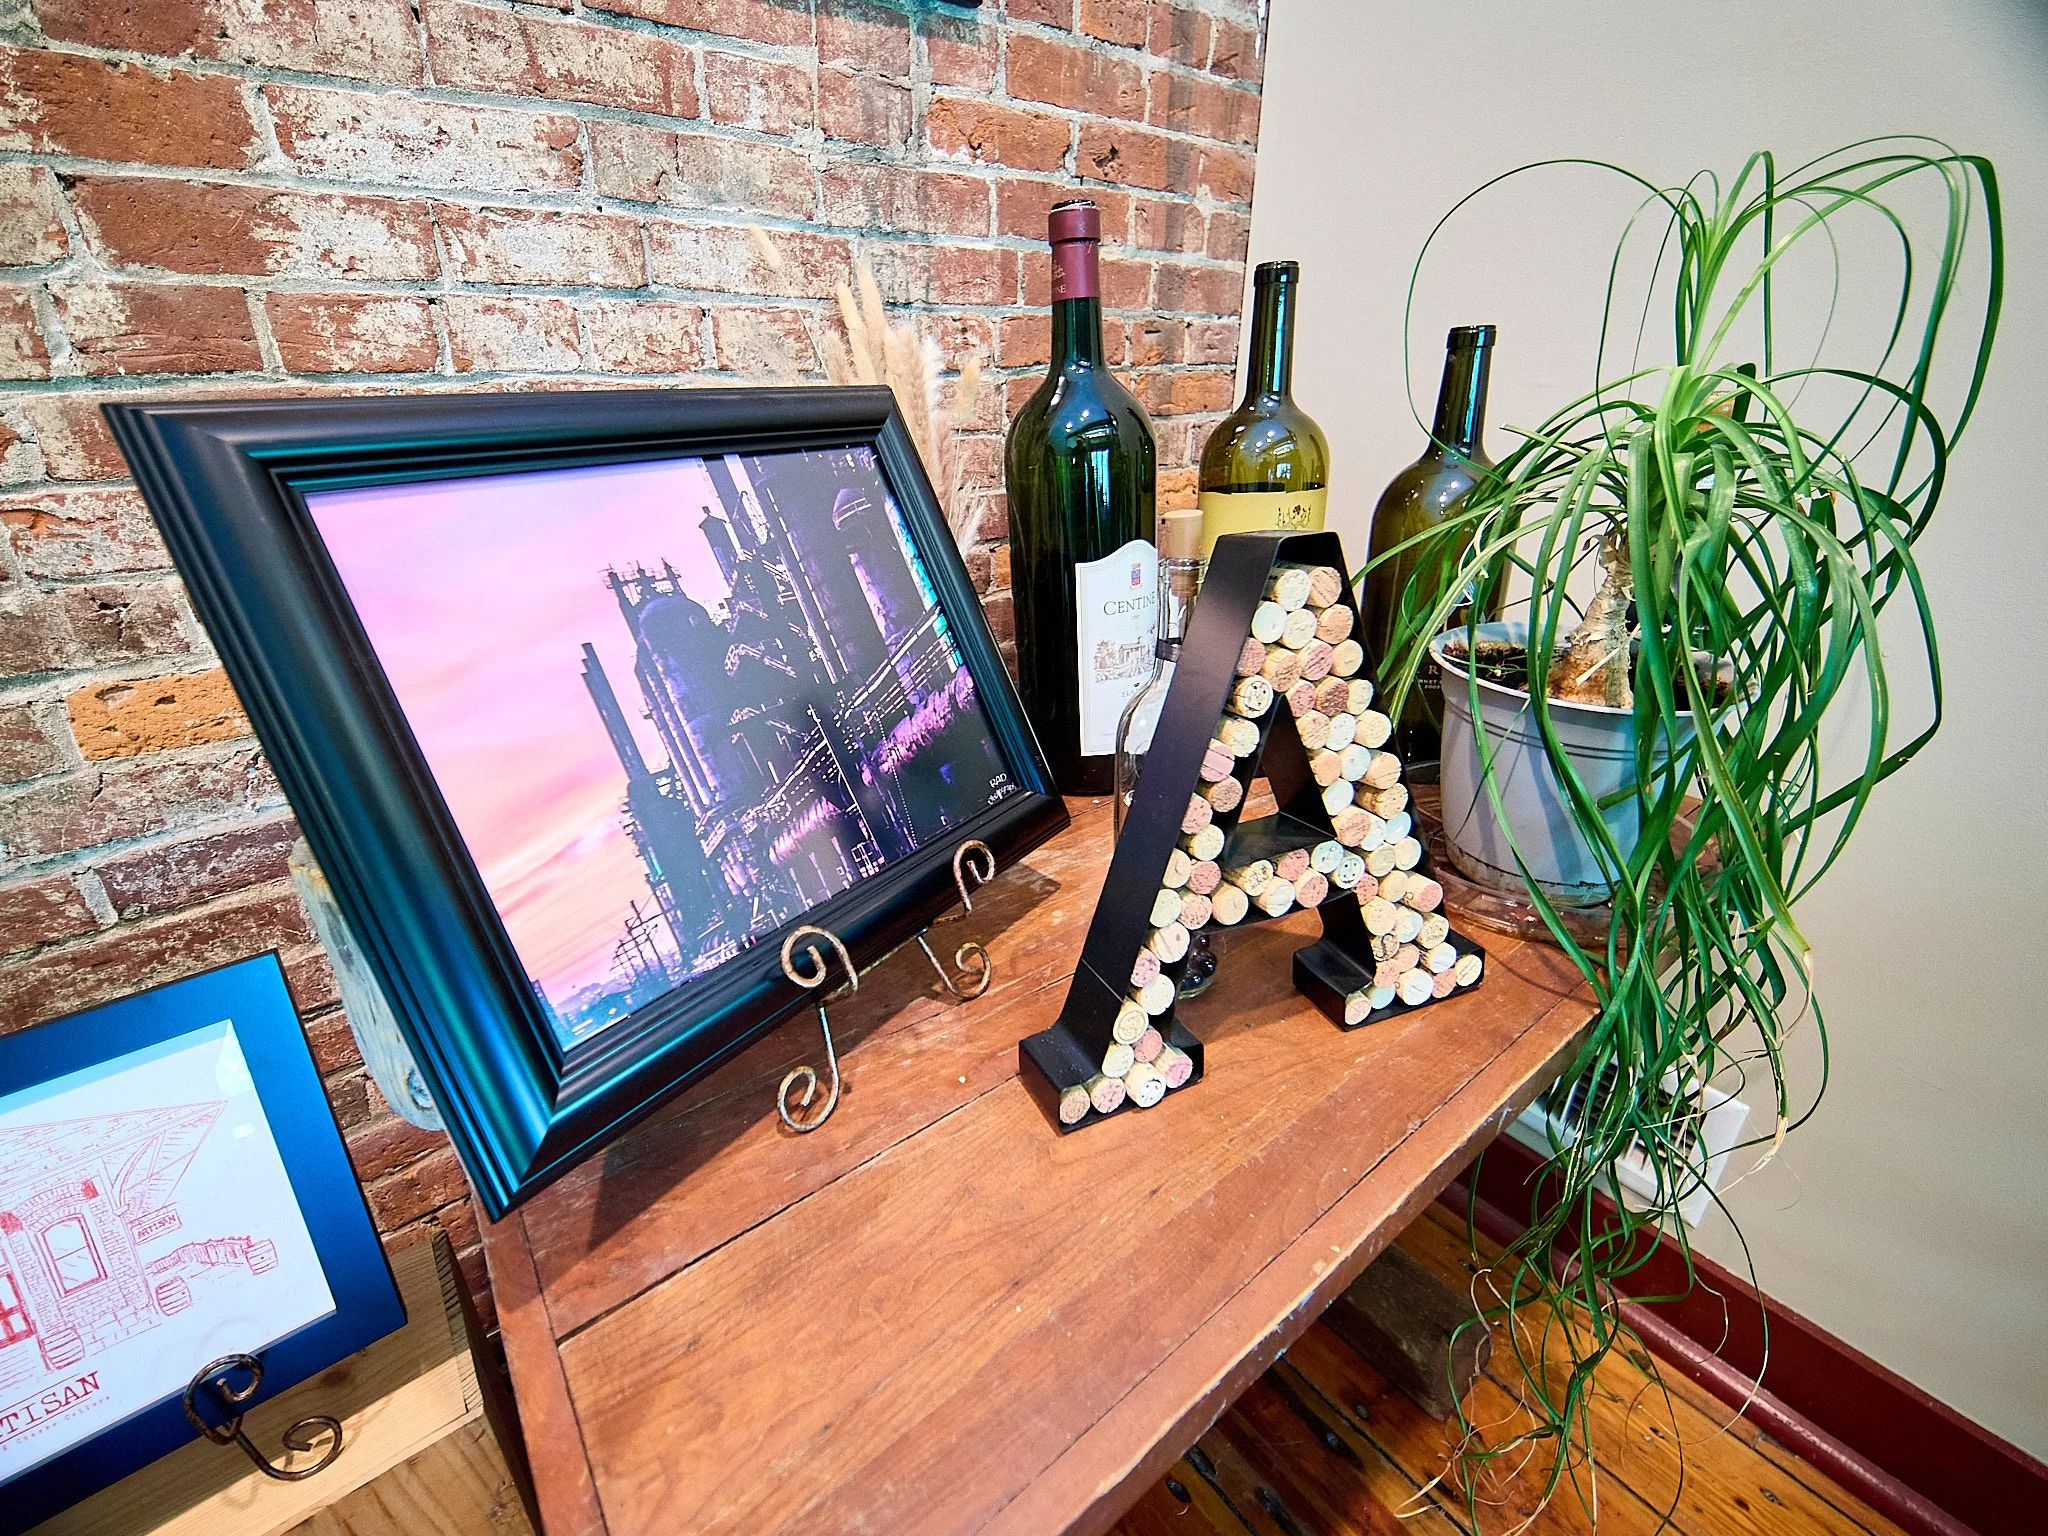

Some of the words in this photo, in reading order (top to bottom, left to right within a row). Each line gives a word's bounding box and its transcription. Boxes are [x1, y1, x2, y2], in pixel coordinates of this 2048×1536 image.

[1103, 591, 1156, 616] CENTINE
[989, 773, 1008, 788] RAD
[137, 1214, 177, 1240] ARTISAN
